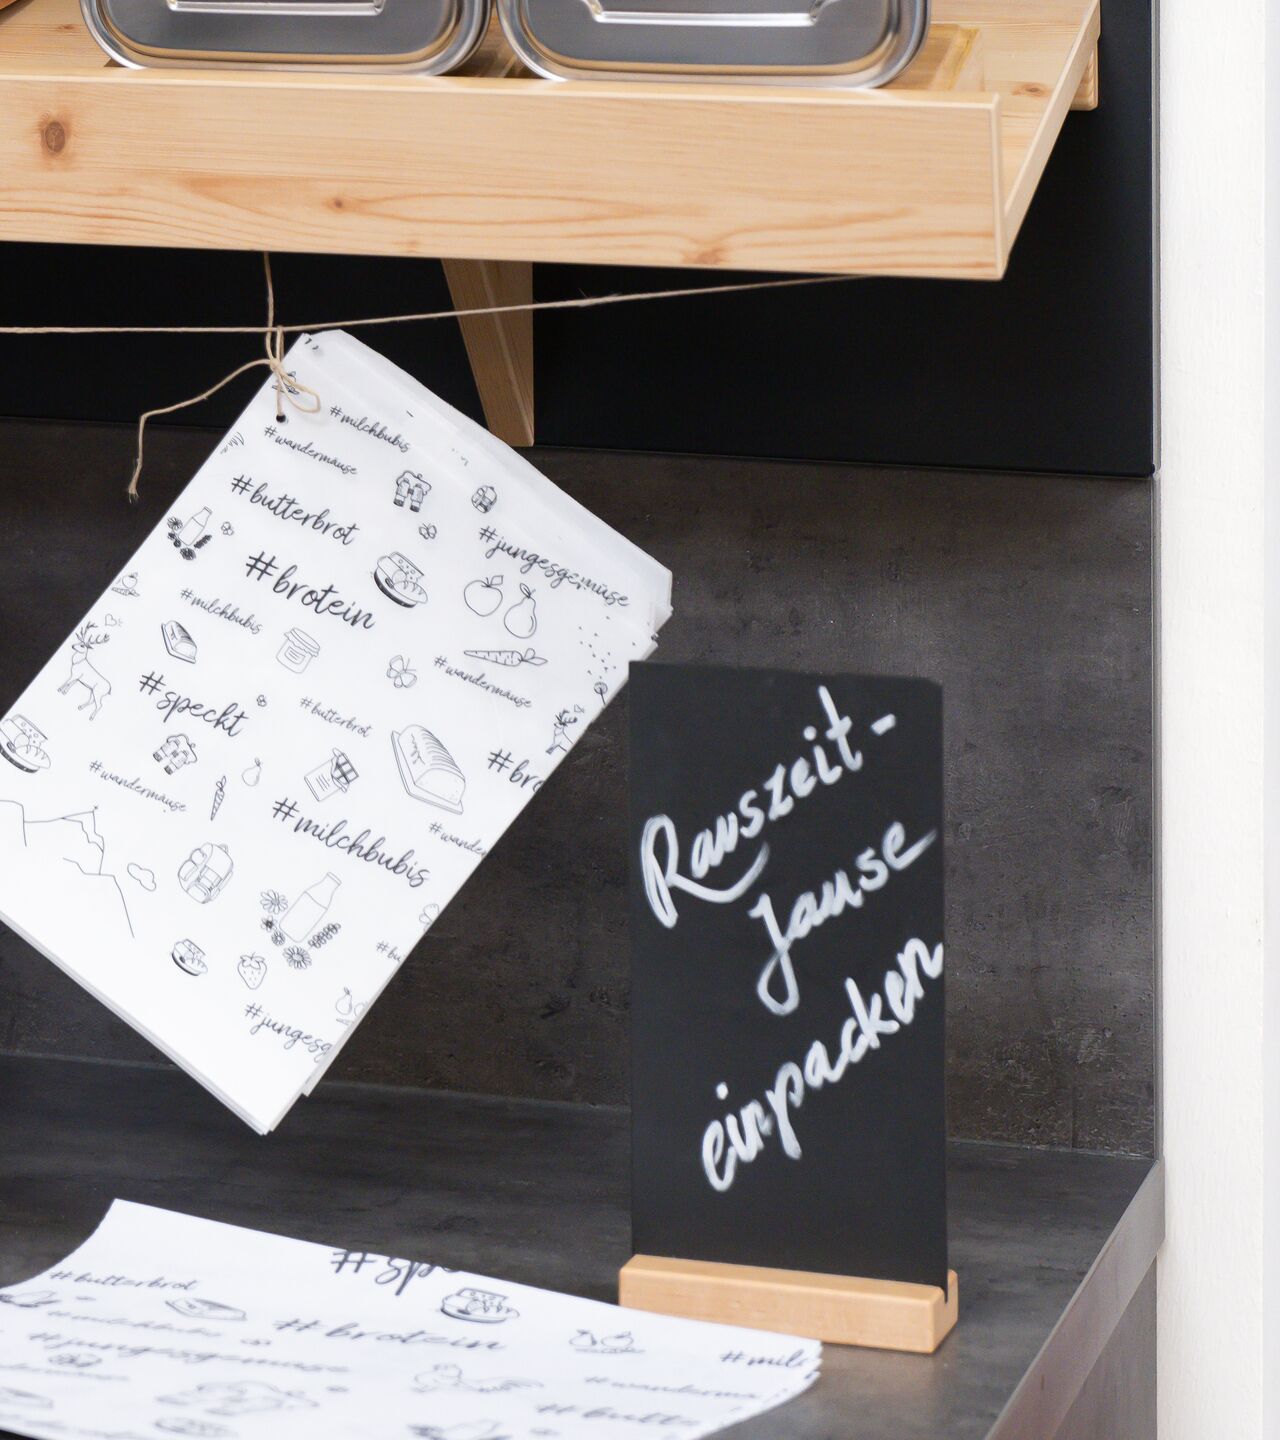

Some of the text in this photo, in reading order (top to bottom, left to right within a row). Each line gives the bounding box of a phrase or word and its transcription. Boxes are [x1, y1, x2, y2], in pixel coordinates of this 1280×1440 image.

[328, 405, 413, 453] #milchbubis
[230, 474, 360, 546] #butterbrot
[245, 550, 376, 631] #brotein
[479, 525, 629, 607] #jungesgemüse
[180, 588, 263, 635] #milchbubis
[139, 671, 249, 737] #speckt
[299, 696, 373, 739] #butterbrot
[272, 797, 431, 888] #milchbubis
[749, 823, 934, 1015] Jause
[702, 938, 943, 1191] einpacken
[273, 1316, 511, 1351] #brotein
